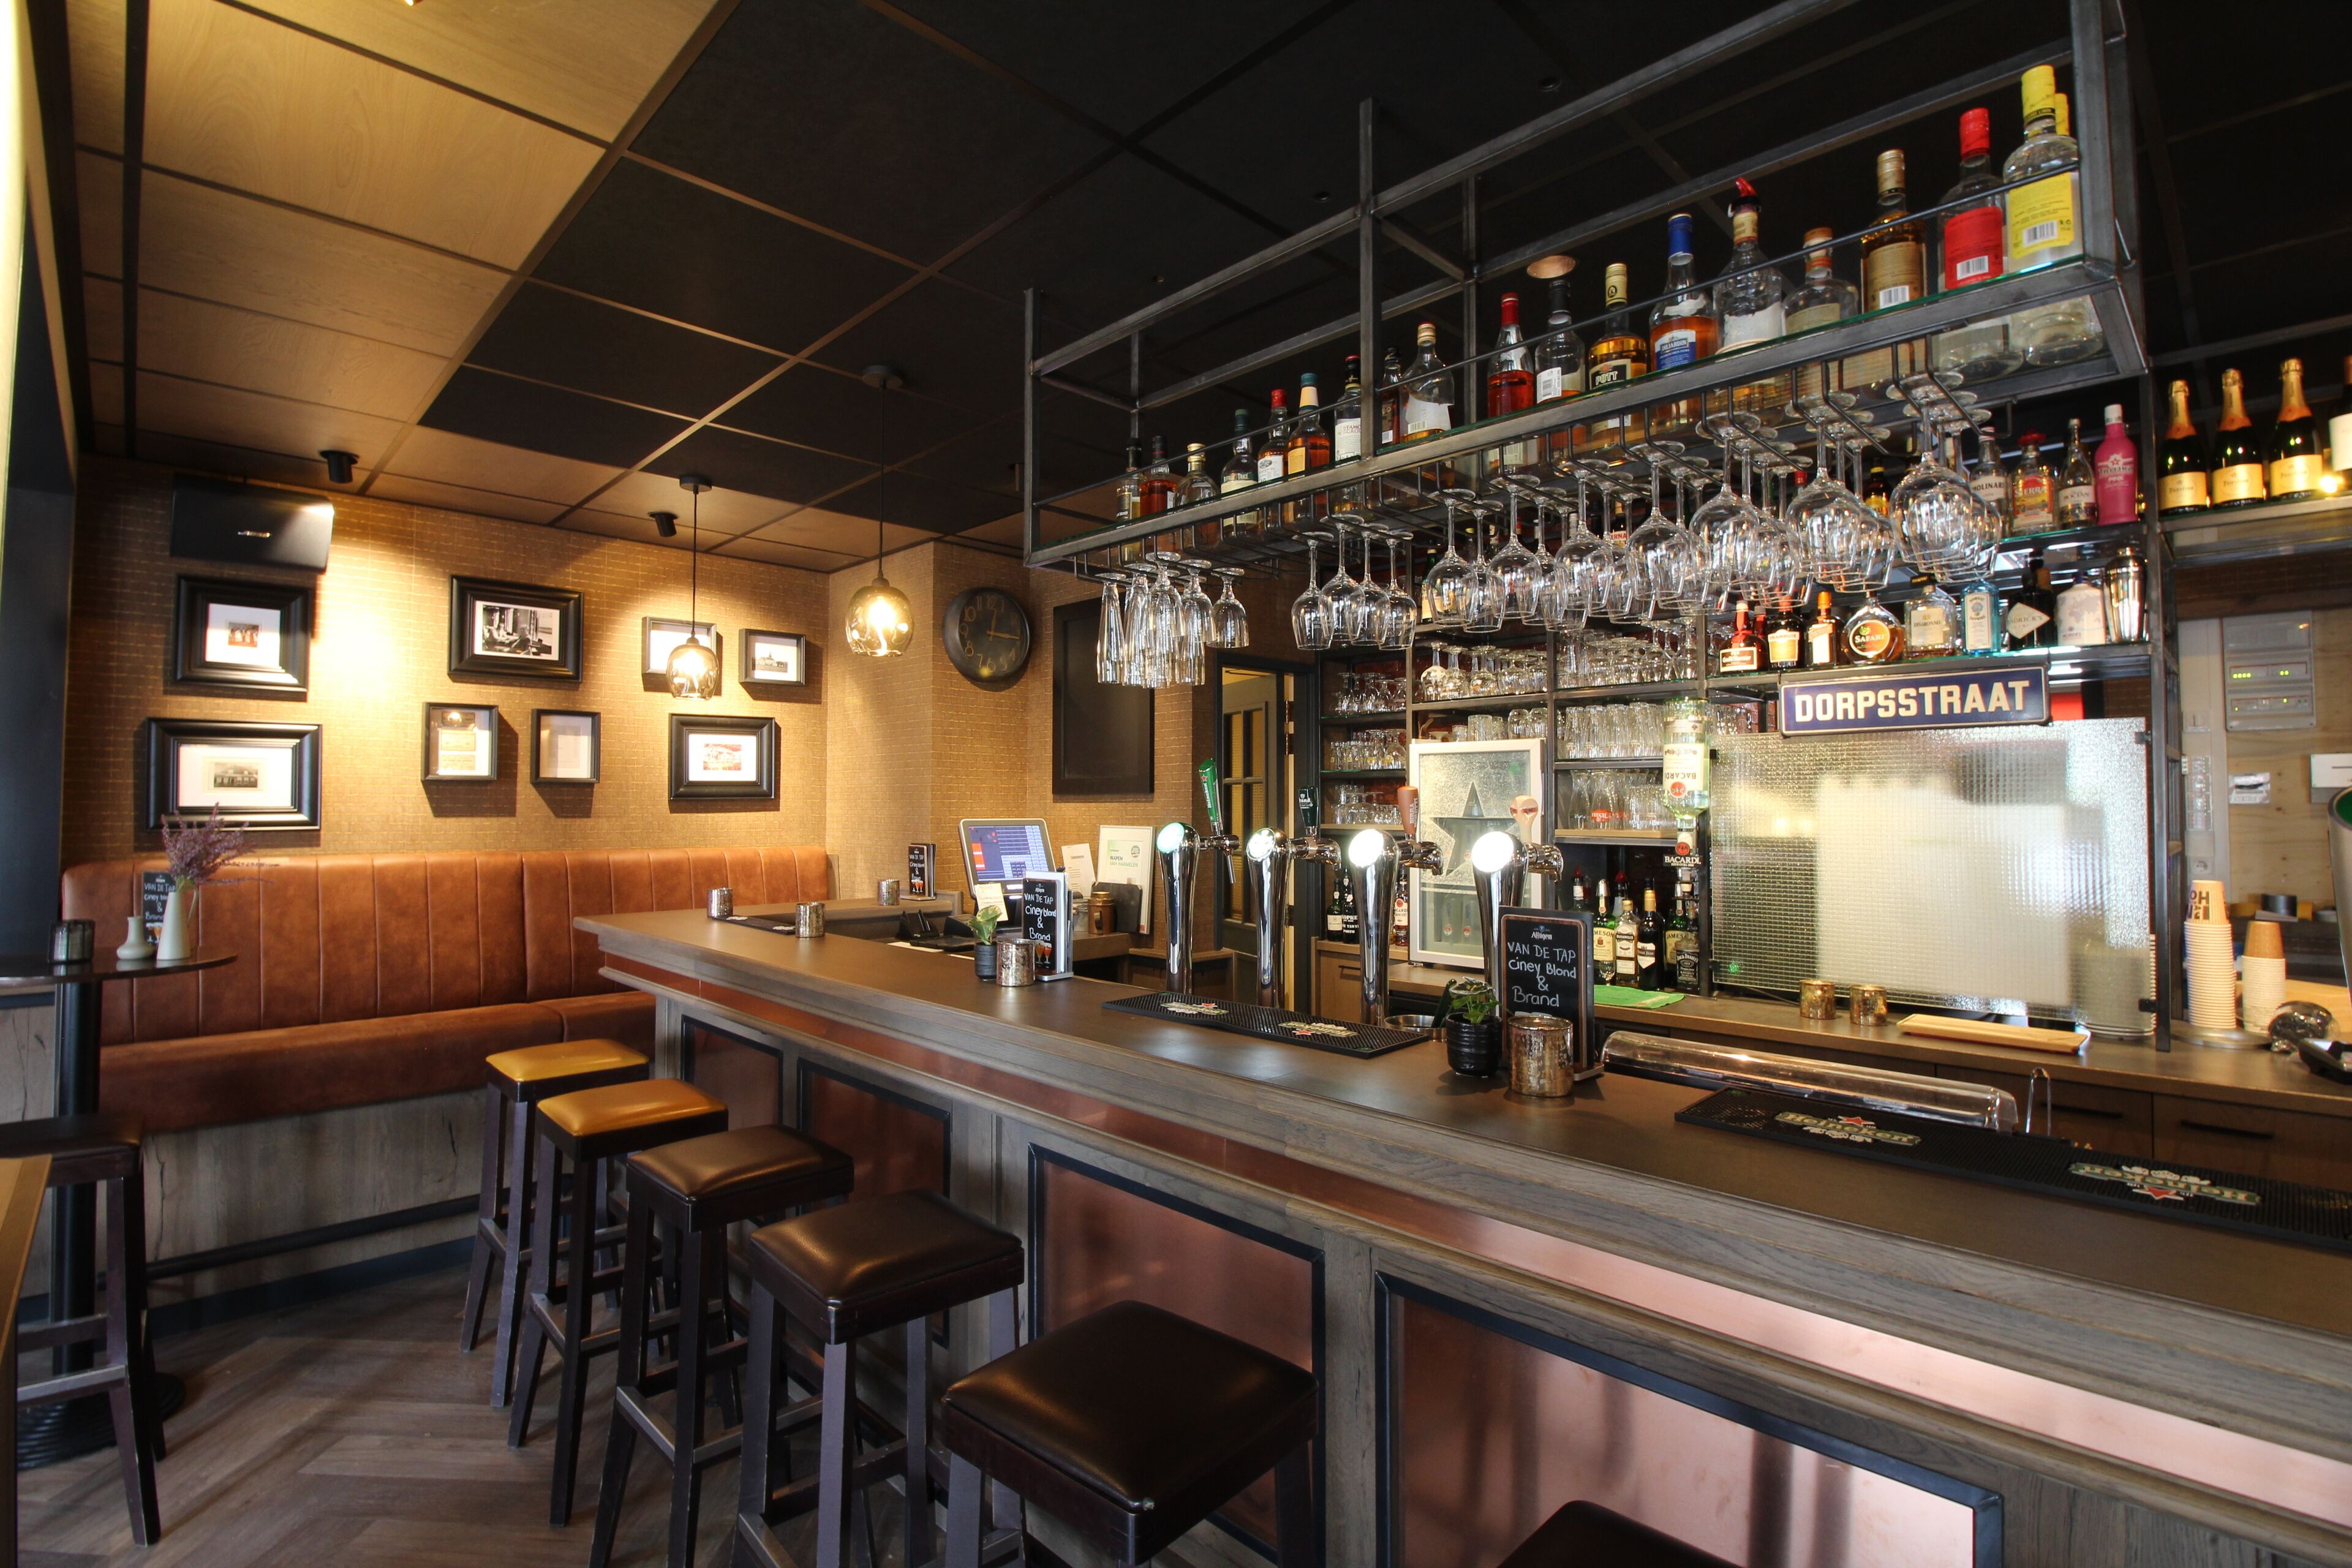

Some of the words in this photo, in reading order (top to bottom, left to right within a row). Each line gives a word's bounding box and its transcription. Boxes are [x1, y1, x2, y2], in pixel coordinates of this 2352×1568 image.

[1596, 371, 1618, 385] POTT
[964, 606, 976, 622] 10
[960, 623, 968, 638] 9
[1855, 635, 1884, 643] SAFARI
[965, 641, 973, 657] 8
[978, 654, 983, 668] 7
[1795, 680, 2029, 723] DORPSSTRAAT
[1203, 783, 1212, 808] Heineken
[1665, 856, 1700, 864] BACARDI
[1024, 893, 1035, 902] VAN
[1035, 894, 1042, 903] DE
[1044, 895, 1054, 905] TAP
[157, 902, 162, 912] &
[1037, 917, 1044, 929] &
[1029, 927, 1050, 941] Brand
[1531, 932, 1552, 940] Affligem
[1507, 941, 1529, 955] VAN
[1533, 945, 1550, 959] DE
[1553, 948, 1576, 963] TAP
[1547, 962, 1576, 979] Blond
[1537, 976, 1548, 992] &
[1512, 986, 1559, 1007] Brand
[1784, 1113, 1916, 1143] Heineken
